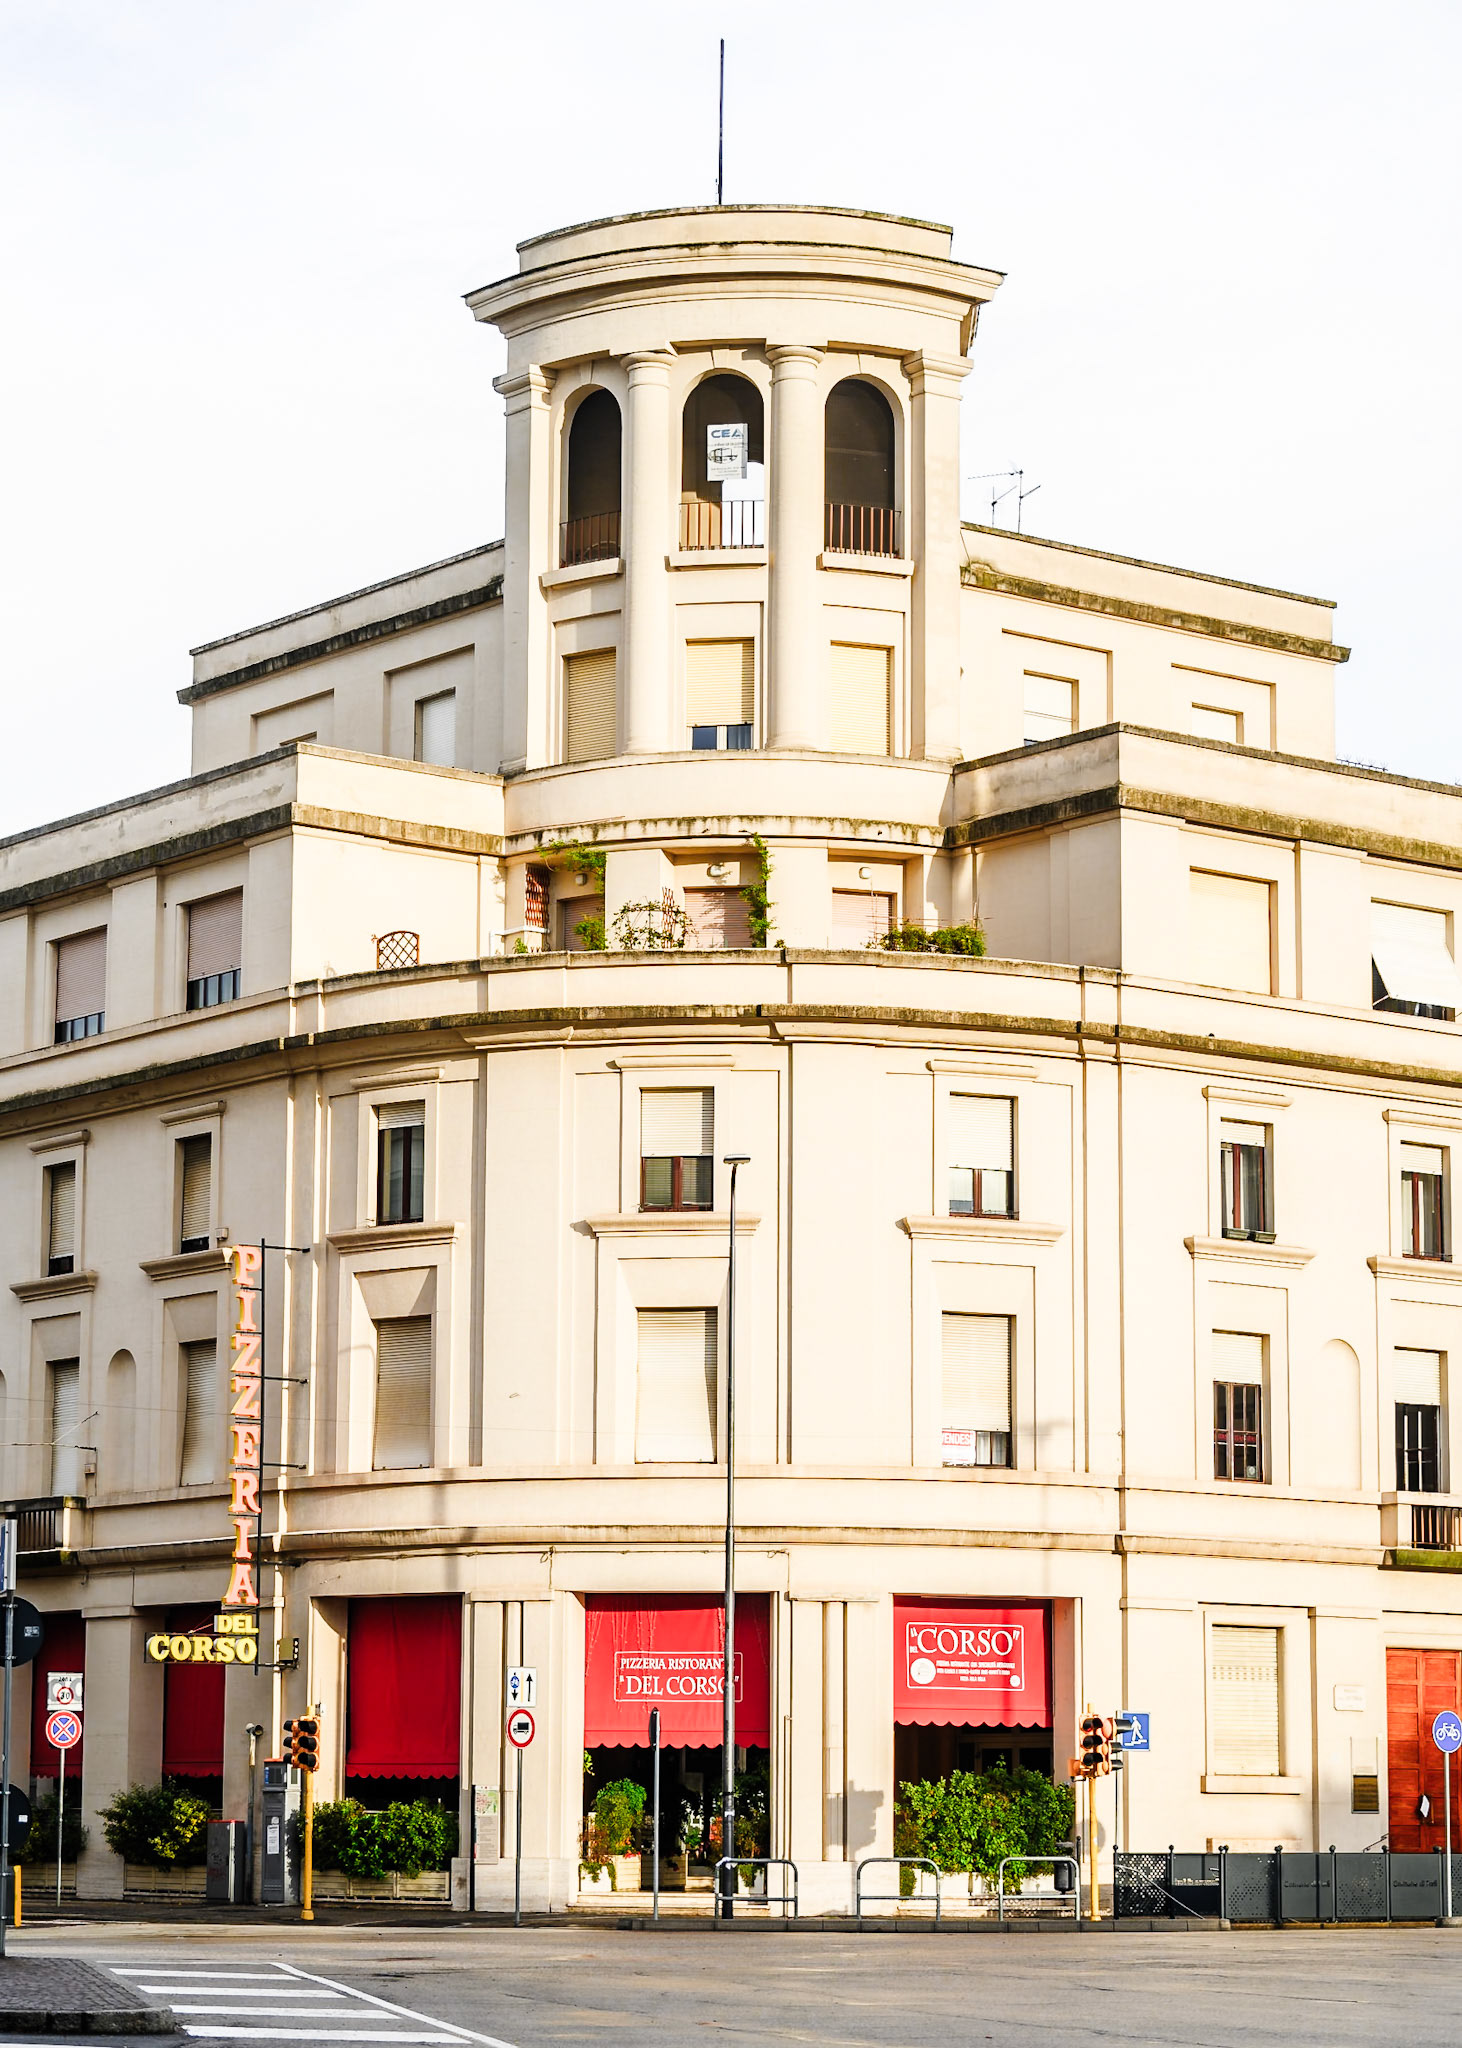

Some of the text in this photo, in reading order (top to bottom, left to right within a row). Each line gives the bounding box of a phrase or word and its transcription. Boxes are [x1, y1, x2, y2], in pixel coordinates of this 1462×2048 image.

[711, 428, 744, 438] CEA
[225, 1244, 262, 1605] PIZZERIA
[215, 1614, 259, 1634] DEL
[146, 1634, 258, 1663] CORSO
[620, 1657, 735, 1670] PIZZERIA RISTORAN
[60, 1692, 71, 1700] 30
